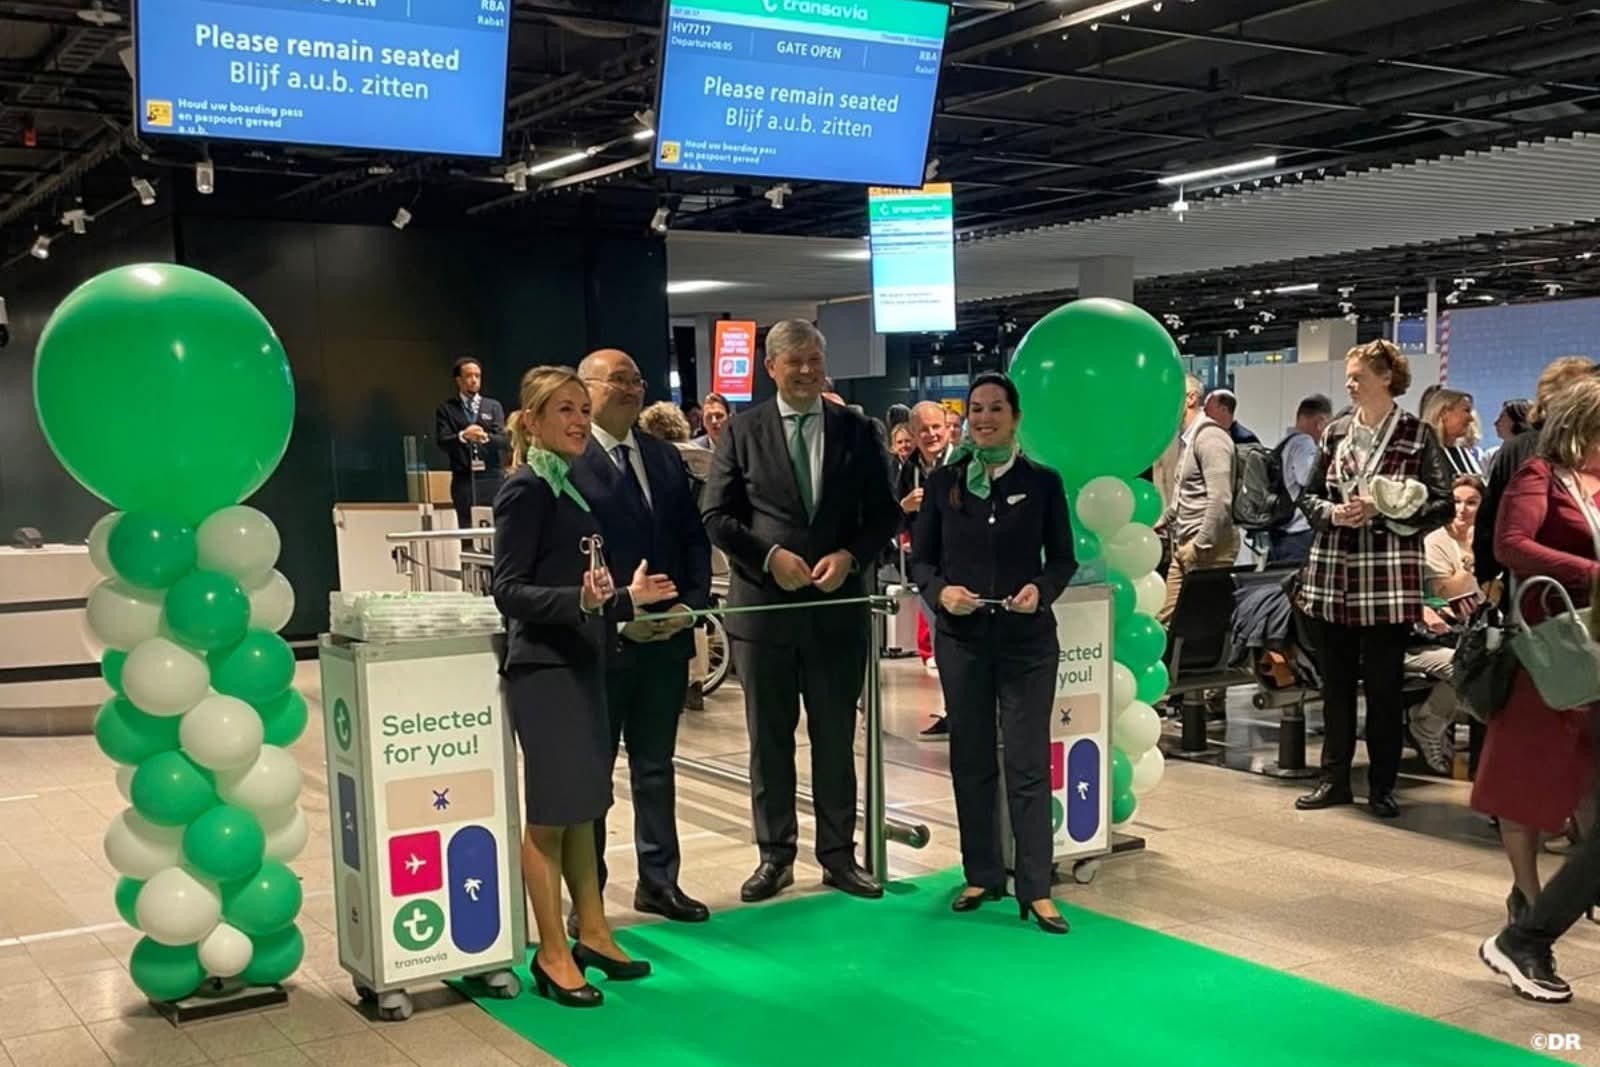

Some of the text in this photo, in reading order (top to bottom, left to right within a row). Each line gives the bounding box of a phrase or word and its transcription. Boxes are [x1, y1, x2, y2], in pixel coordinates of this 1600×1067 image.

[481, 0, 505, 12] RBA
[782, 0, 869, 20] transavia
[477, 15, 504, 28] Rabat
[672, 21, 712, 36] HV7717
[195, 23, 460, 72] Please remain seated
[776, 40, 841, 60] GATE OPEN
[230, 60, 429, 100] Blijf a.u.b. zitten
[703, 75, 899, 113] Please remain seated
[177, 98, 304, 118] Houd uw boarding pass
[177, 112, 283, 129] en paspoort gereed
[725, 106, 873, 139] Blijf a.u.b. zitten
[1059, 642, 1102, 662] ected
[1059, 665, 1092, 689] you!
[382, 705, 493, 737] Selected
[384, 743, 422, 765] for
[427, 733, 479, 766] you!
[394, 953, 448, 969] transavia
